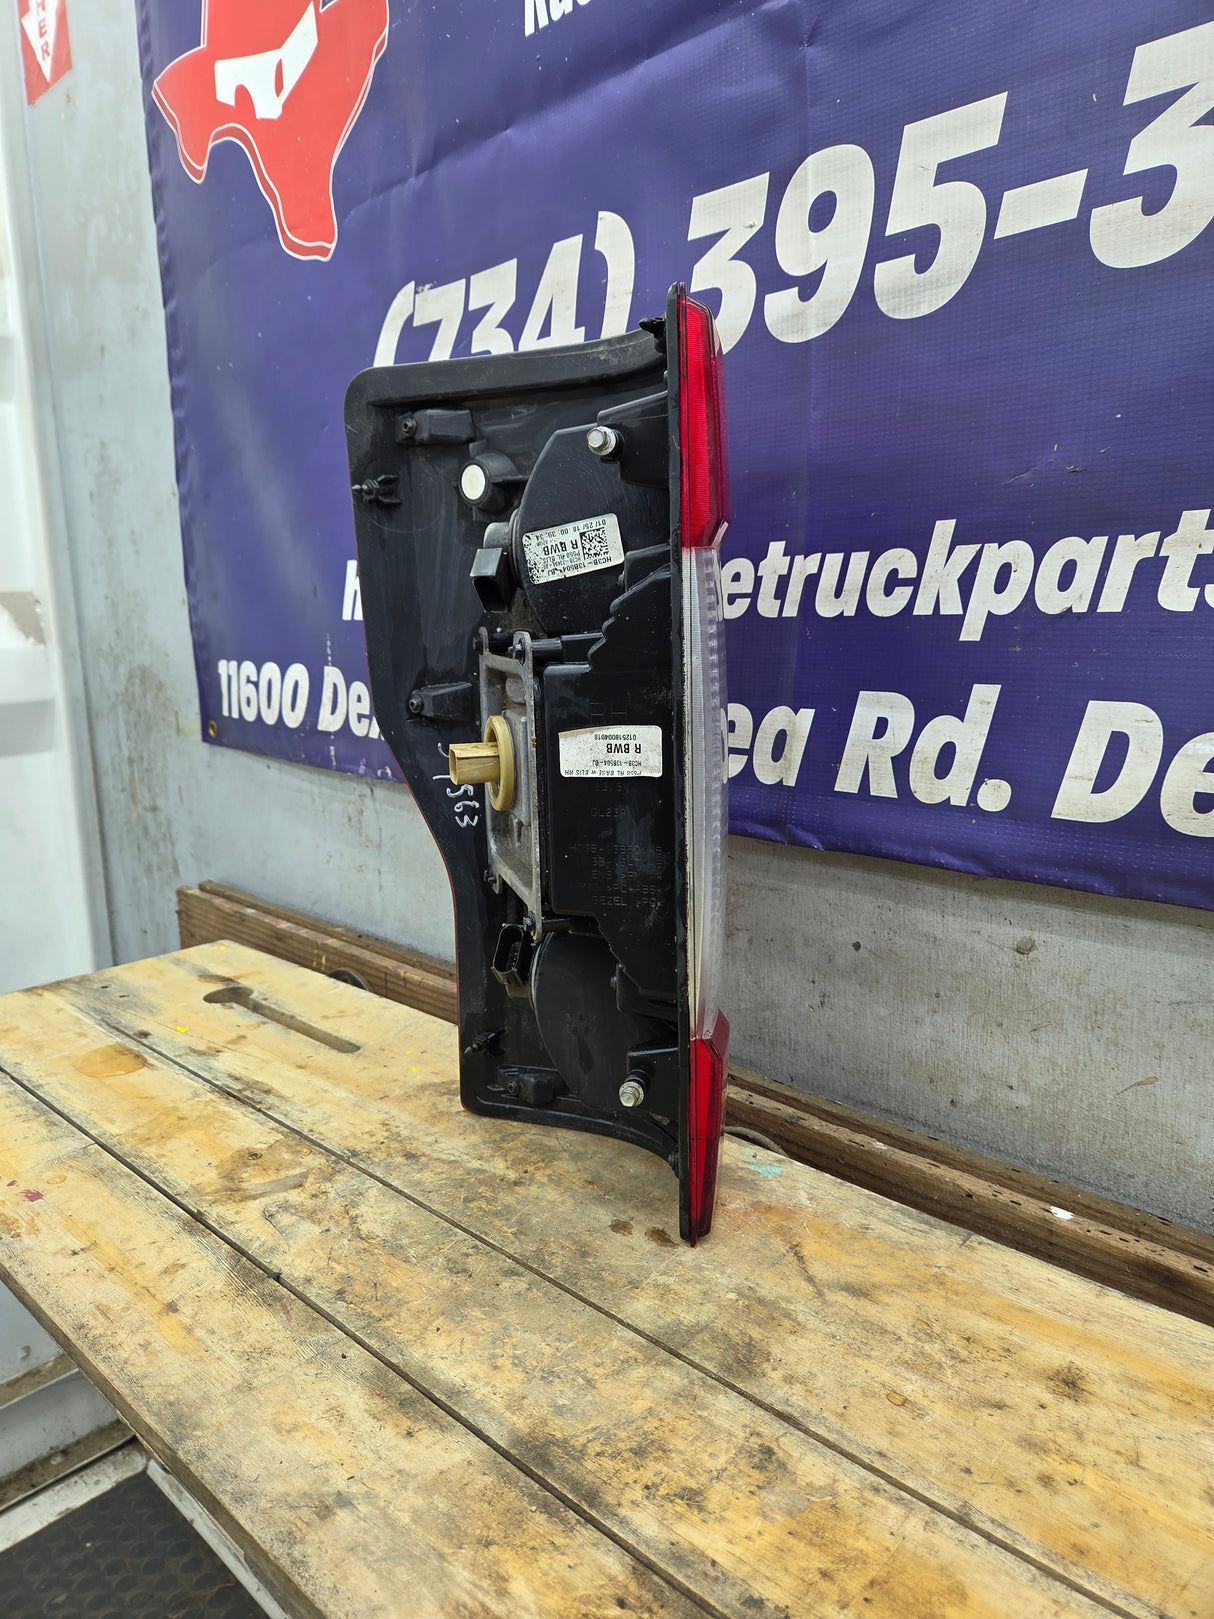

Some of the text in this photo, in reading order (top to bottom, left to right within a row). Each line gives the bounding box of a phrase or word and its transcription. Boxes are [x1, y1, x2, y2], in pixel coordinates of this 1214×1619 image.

[543, 541, 567, 556] BWB
[570, 539, 578, 549] R
[719, 508, 1214, 642] etruckpart
[217, 659, 310, 729] 11600
[724, 702, 816, 787] ea
[834, 683, 1013, 812] Rd.
[606, 743, 642, 754] R BWB
